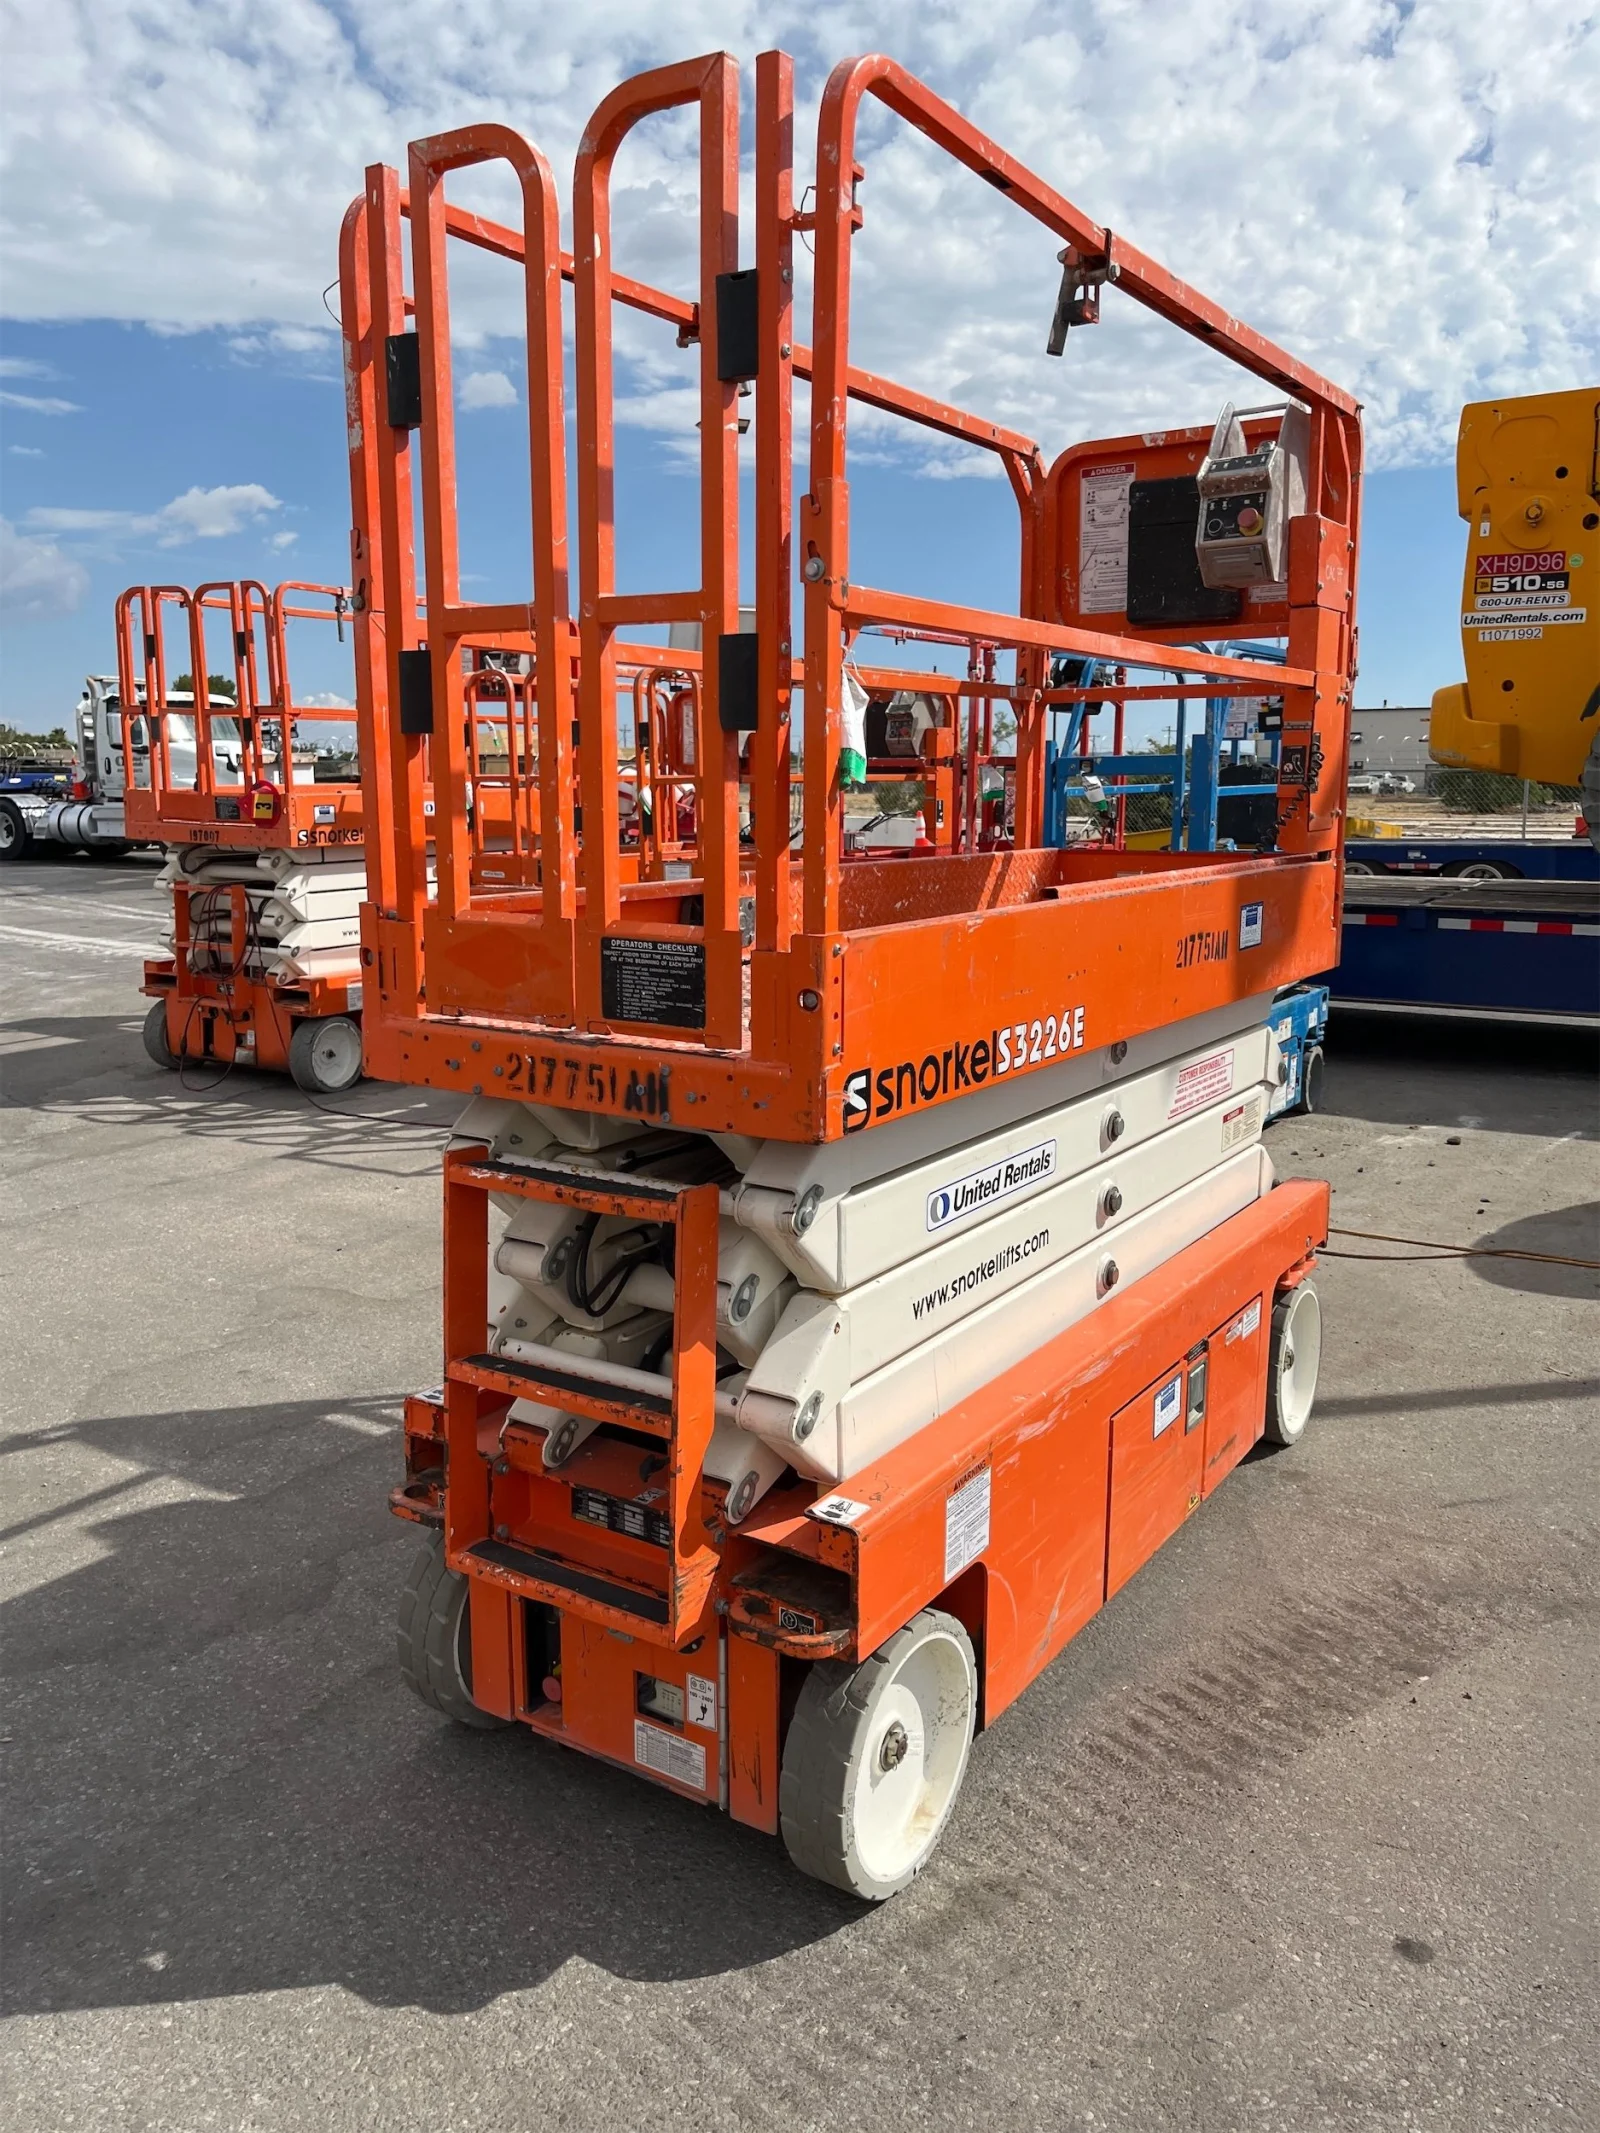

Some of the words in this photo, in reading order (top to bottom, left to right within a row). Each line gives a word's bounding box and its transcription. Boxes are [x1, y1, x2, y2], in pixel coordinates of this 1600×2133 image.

[1096, 466, 1126, 475] DANGER
[1477, 553, 1564, 574] XH9D96
[1480, 595, 1566, 607] 800-UR-RENTS
[1464, 611, 1584, 625] UnitedRentals.com
[1481, 628, 1542, 641] 11071992
[255, 802, 272, 810] 3
[310, 827, 363, 844] snorkel
[610, 939, 653, 950] OPERATORS
[657, 943, 698, 953] CHECKLIST
[997, 1006, 1086, 1076] S3226E
[875, 1030, 998, 1118] snorkel
[953, 1168, 1002, 1212] United
[1003, 1149, 1051, 1188] Rentals
[912, 1228, 1049, 1321] www.snorkellifts.com
[957, 1459, 986, 1488] WARNING
